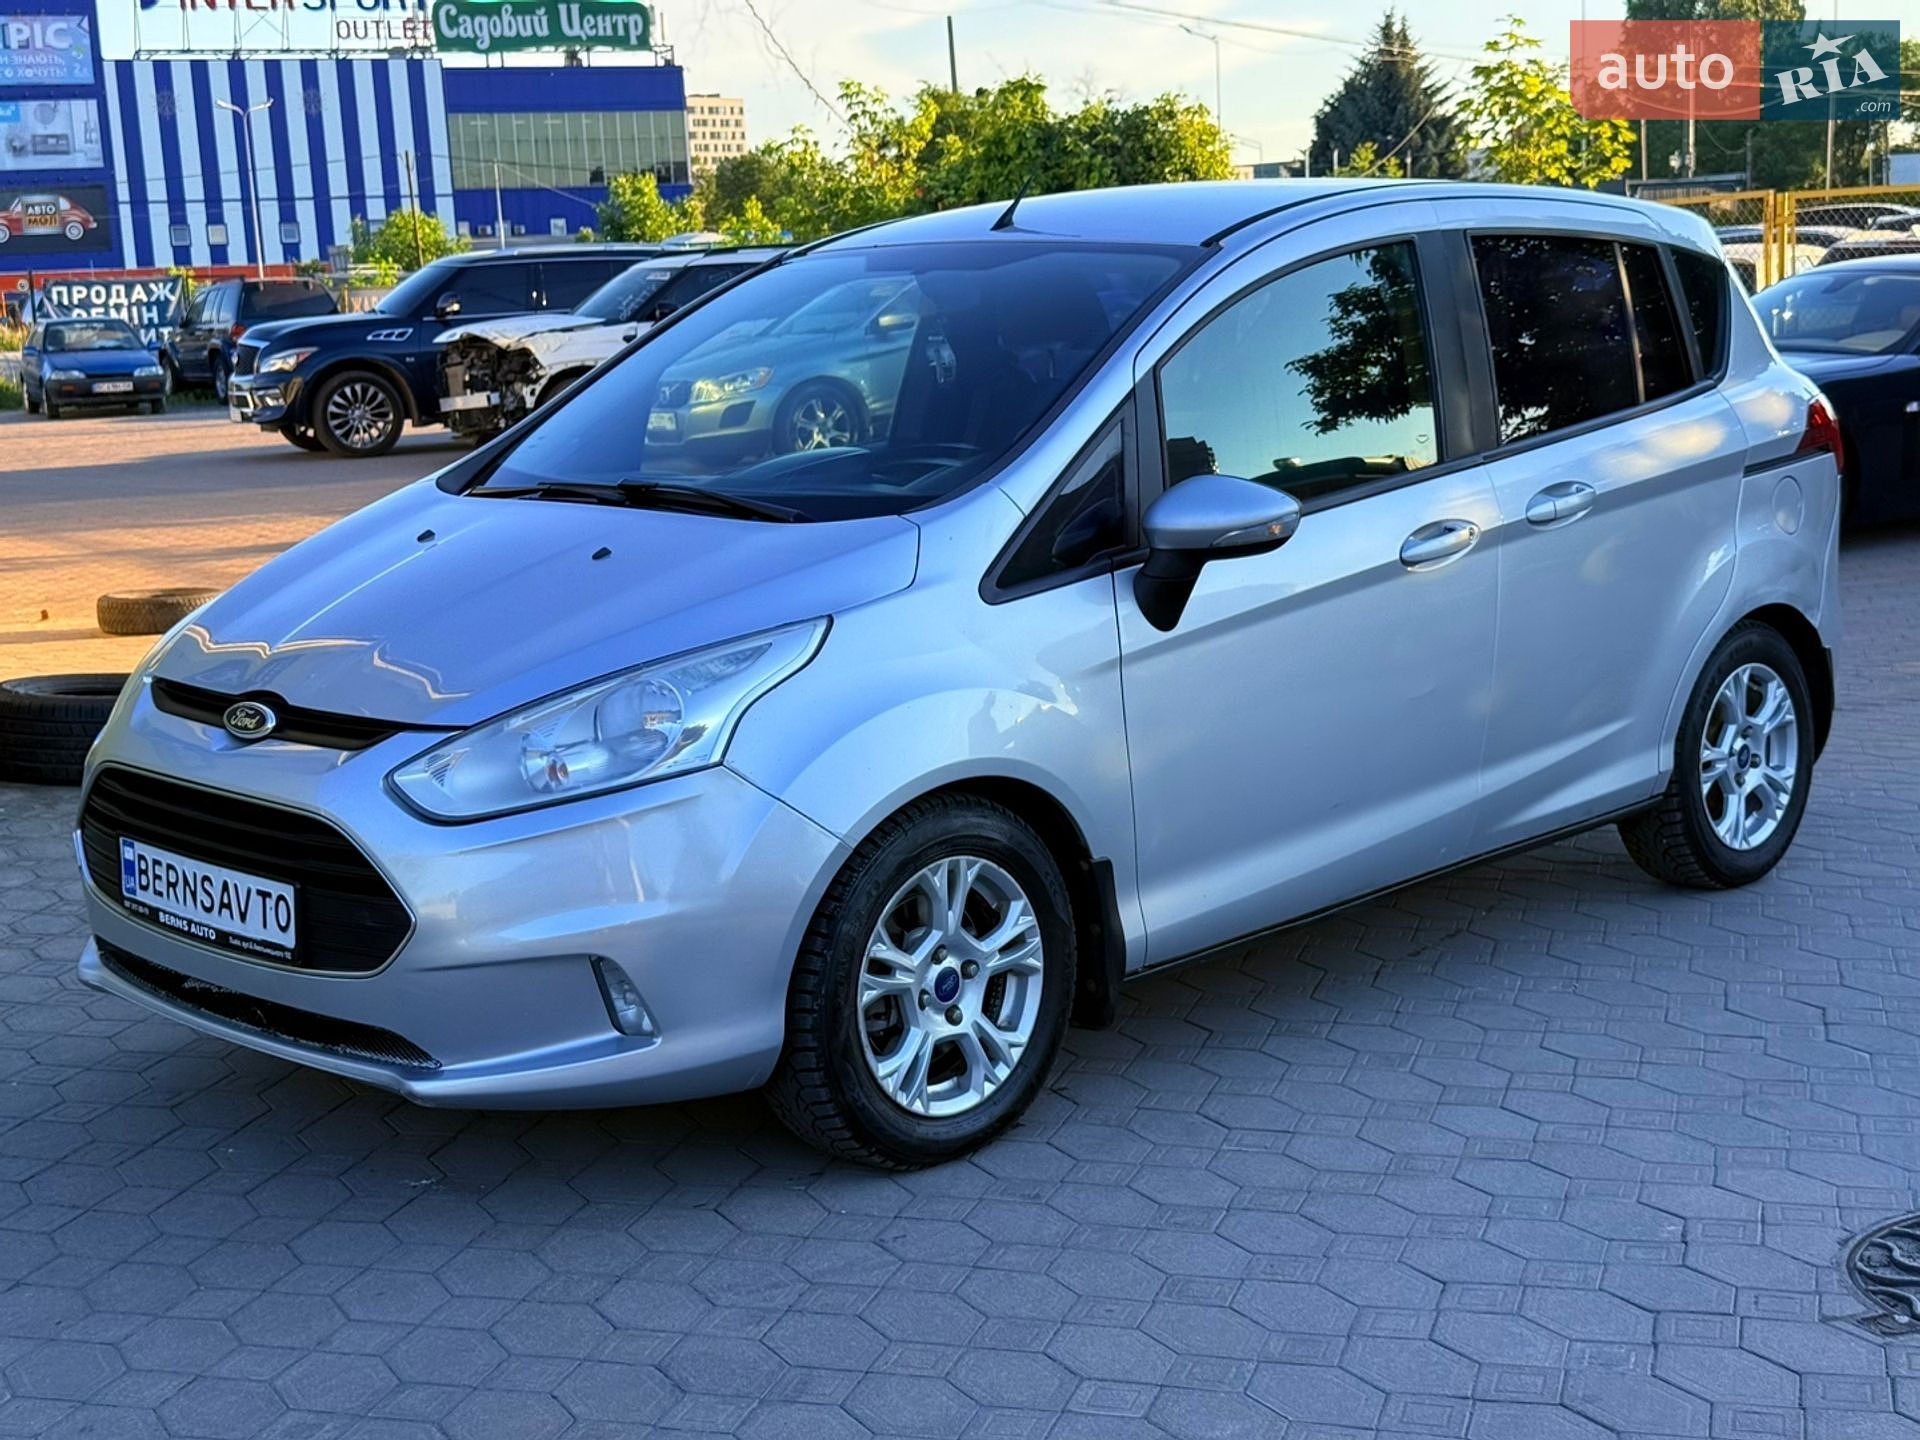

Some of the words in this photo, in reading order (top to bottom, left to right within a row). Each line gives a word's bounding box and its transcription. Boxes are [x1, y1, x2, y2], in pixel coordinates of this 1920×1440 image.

[0, 20, 73, 50] PIC
[336, 18, 432, 40] OUTLET
[438, 4, 549, 50] Садовий
[557, 3, 644, 46] Центр
[51, 281, 176, 306] ПРОДАЖ
[229, 707, 261, 729] Ford
[136, 851, 292, 933] BERNSAVTO
[158, 911, 189, 932] BERNS
[189, 922, 216, 941] AUTO
